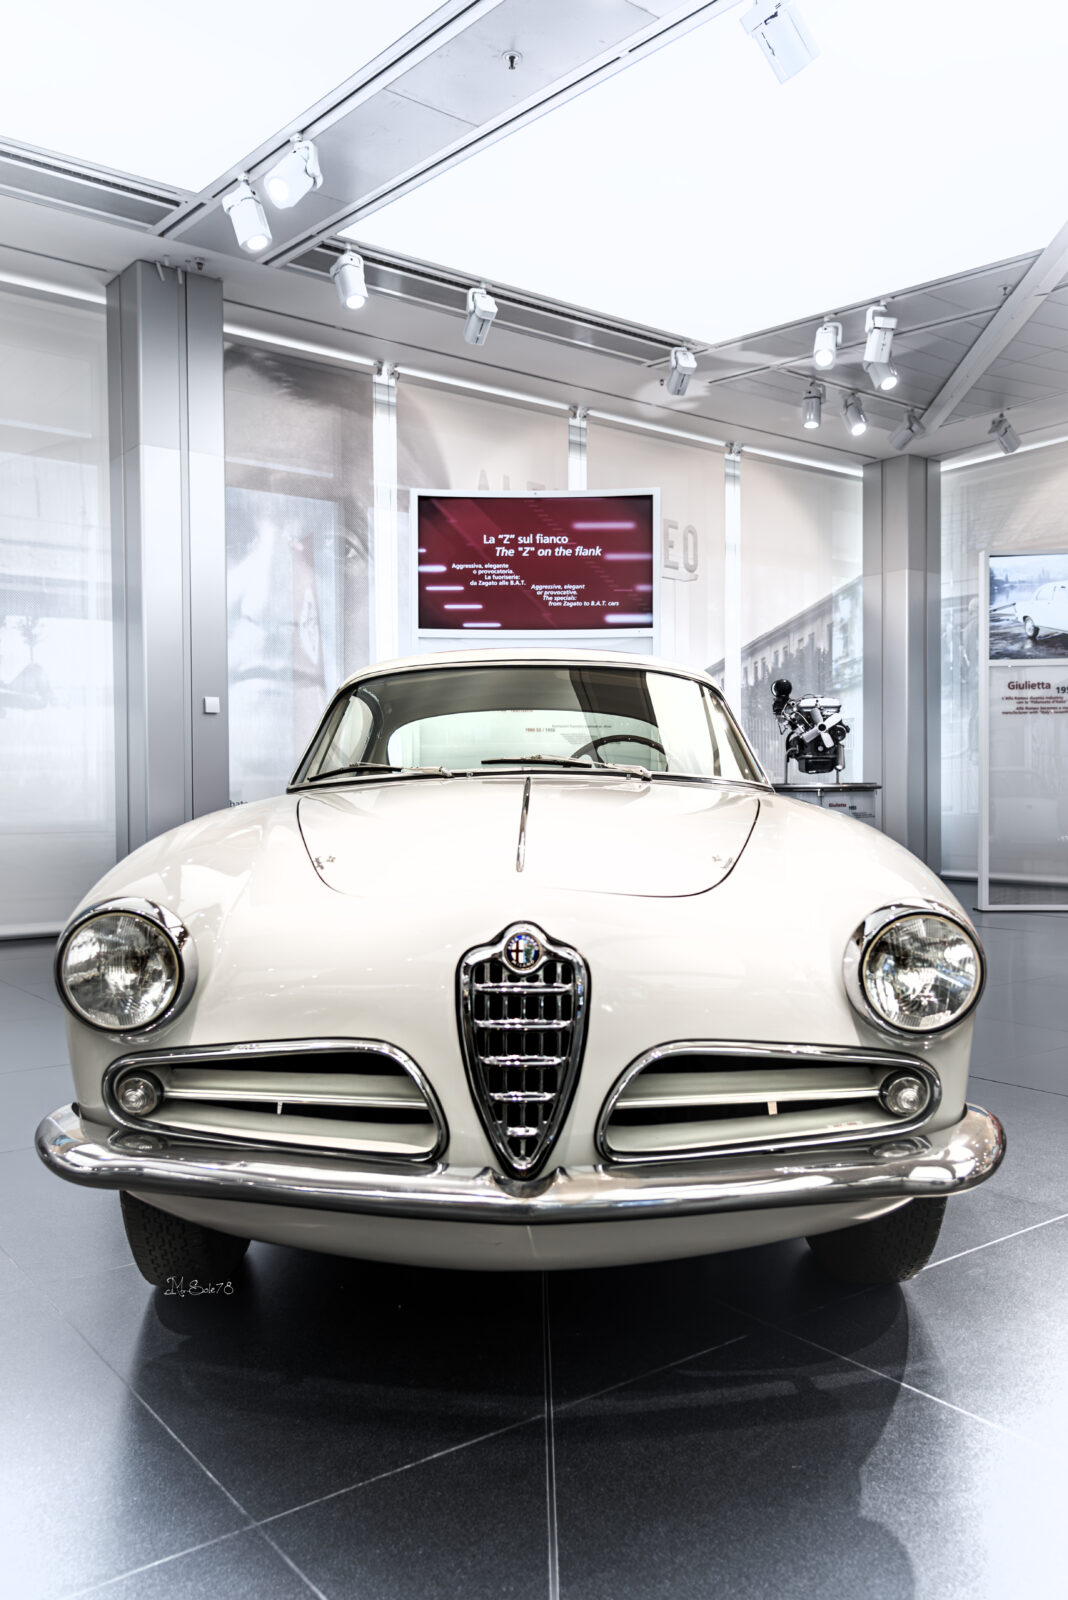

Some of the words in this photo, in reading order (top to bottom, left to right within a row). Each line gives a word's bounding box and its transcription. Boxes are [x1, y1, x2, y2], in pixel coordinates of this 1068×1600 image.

[483, 534, 495, 544] La
[517, 533, 533, 544] sul
[535, 533, 569, 544] fianco
[495, 546, 515, 557] The
[537, 548, 552, 557] on
[554, 546, 572, 556] the
[575, 545, 602, 556] flank
[451, 562, 483, 570] Aggressiva,
[484, 562, 509, 570] elegante
[563, 583, 586, 591] elegant
[562, 600, 582, 608] Zagato
[1007, 680, 1052, 690] Giulietta
